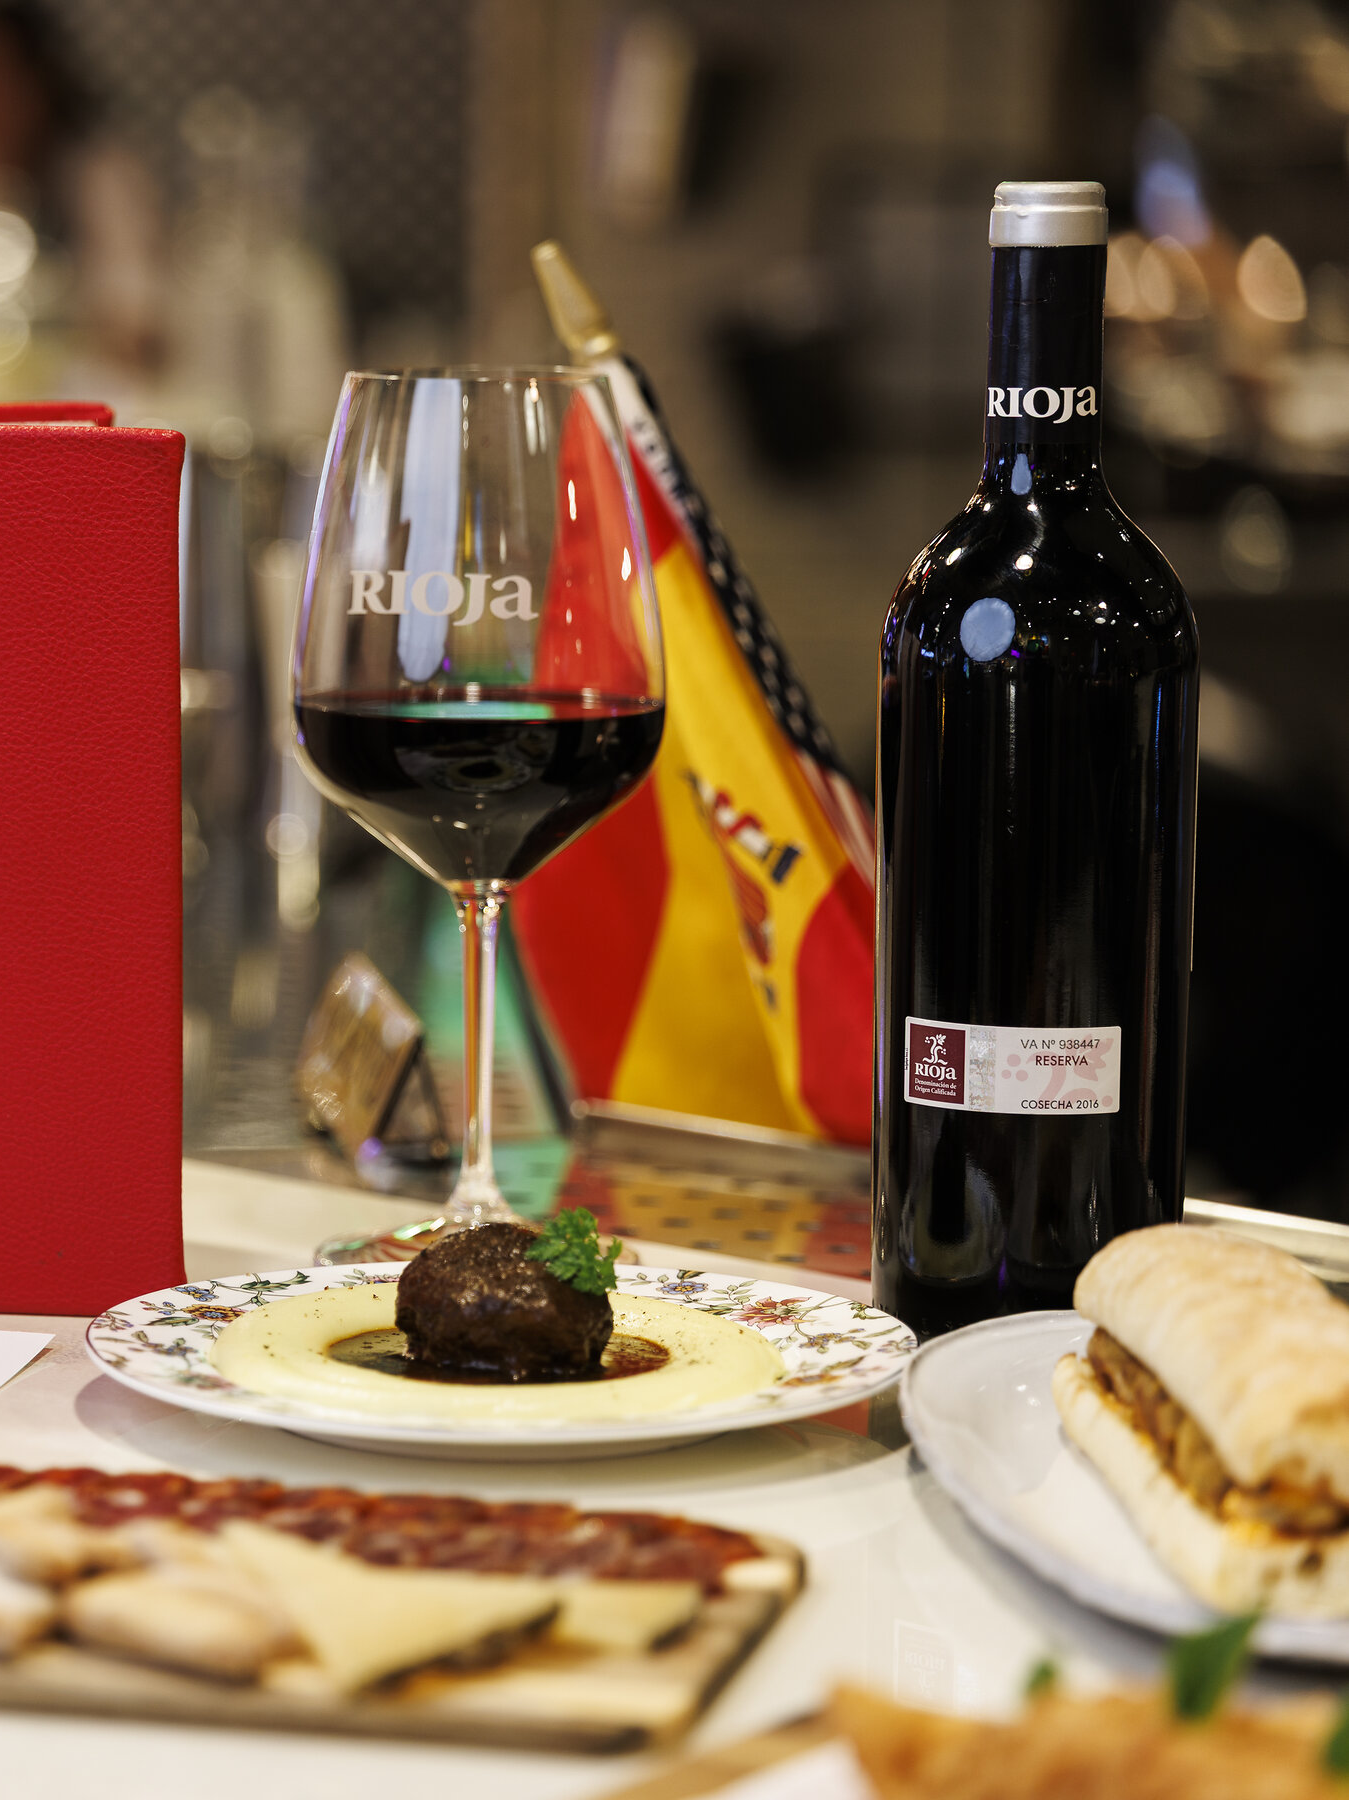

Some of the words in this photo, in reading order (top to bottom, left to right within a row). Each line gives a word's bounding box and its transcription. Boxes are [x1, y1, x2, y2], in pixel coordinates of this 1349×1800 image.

[1020, 1038, 1039, 1050] VA
[1058, 1039, 1100, 1050] 938447
[1035, 1055, 1088, 1067] RESERVA
[914, 1077, 950, 1089] Denominación
[950, 1082, 957, 1090] de
[914, 1084, 930, 1096] Origen
[930, 1086, 957, 1097] Calificada
[1021, 1099, 1073, 1110] COSECHA
[1076, 1099, 1099, 1109] 2016
